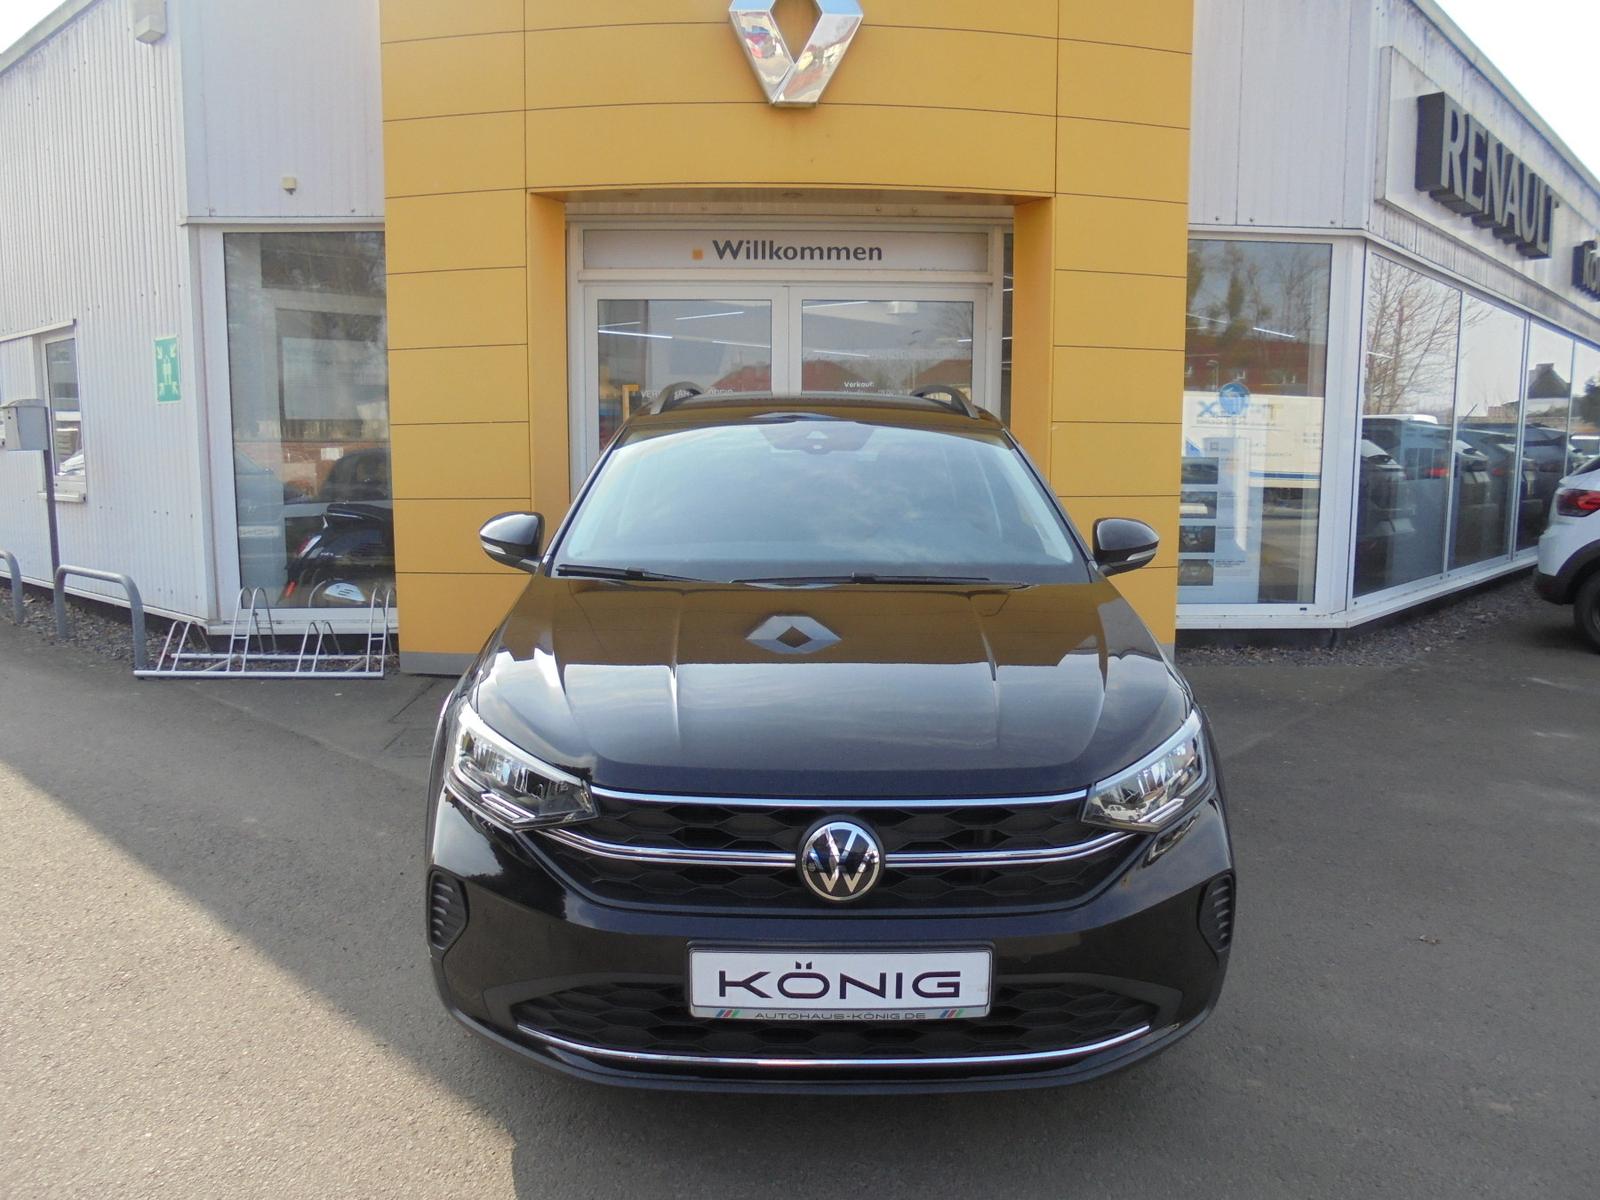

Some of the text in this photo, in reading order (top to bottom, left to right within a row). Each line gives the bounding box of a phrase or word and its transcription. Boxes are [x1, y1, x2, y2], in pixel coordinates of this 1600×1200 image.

[712, 239, 883, 261] Willkommen
[802, 822, 880, 900] VW
[718, 961, 961, 999] KÖNIG
